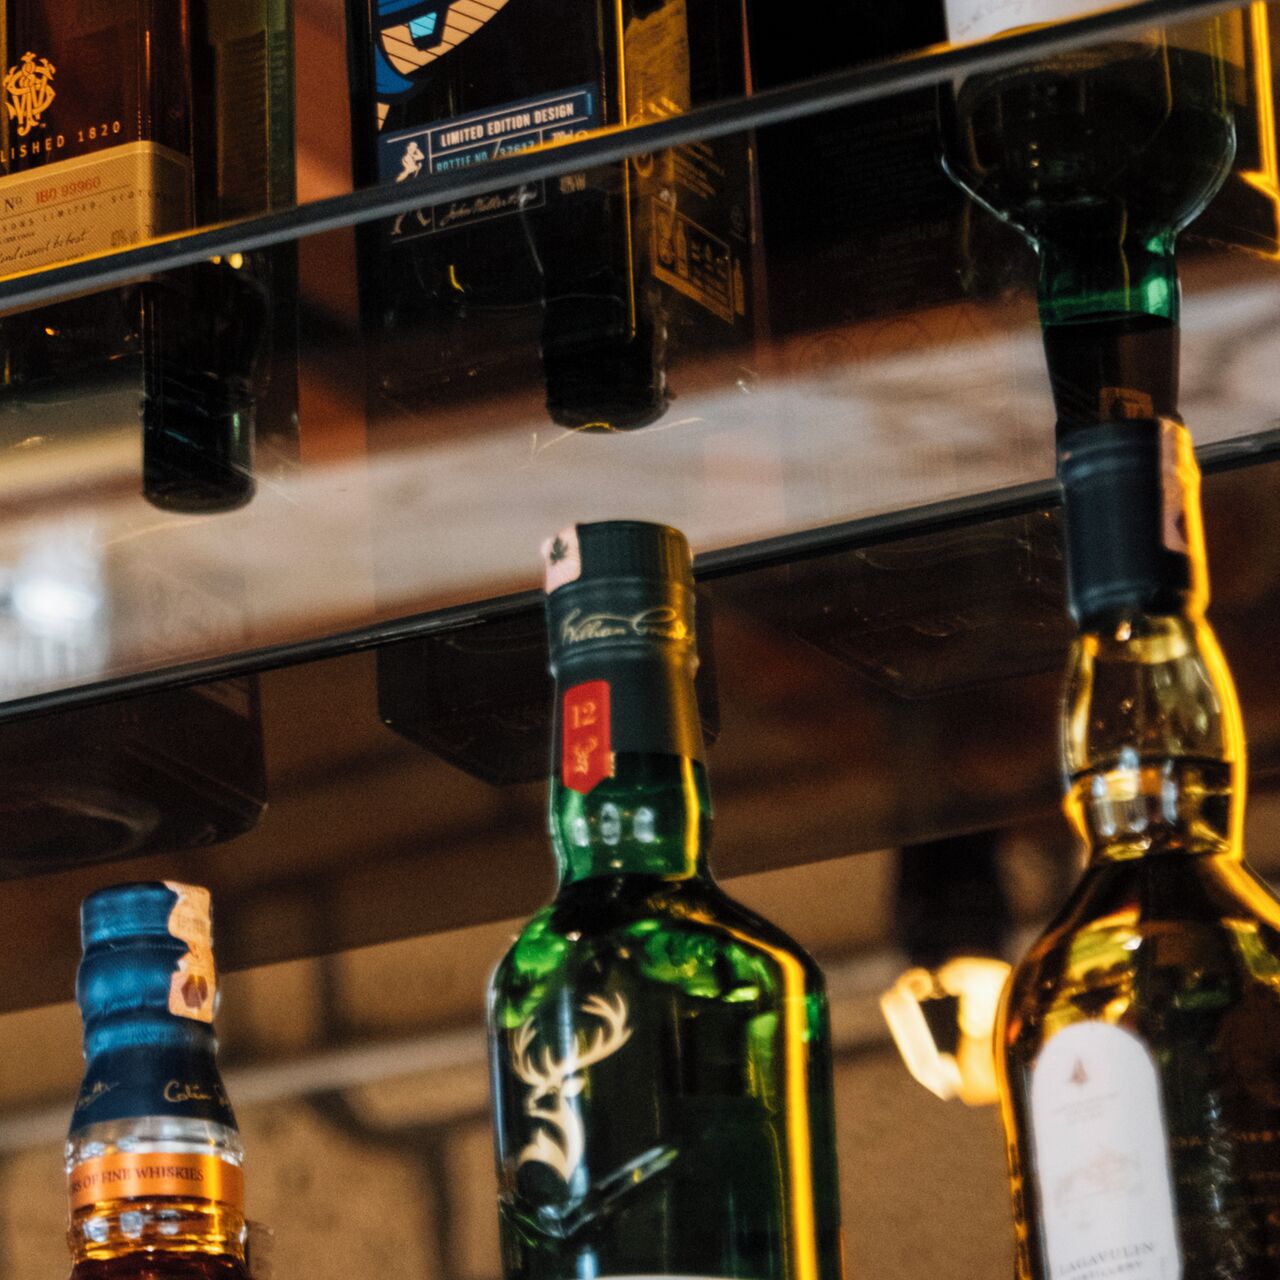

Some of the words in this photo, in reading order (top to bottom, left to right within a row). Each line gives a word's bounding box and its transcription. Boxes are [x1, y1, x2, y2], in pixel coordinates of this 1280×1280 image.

[78, 120, 122, 142] 1820
[439, 124, 484, 148] LIMITED
[487, 113, 531, 137] EDITION
[534, 102, 575, 124] DESIGN
[571, 702, 597, 730] 12
[101, 1169, 130, 1184] FINE
[136, 1166, 205, 1182] WHISKIES
